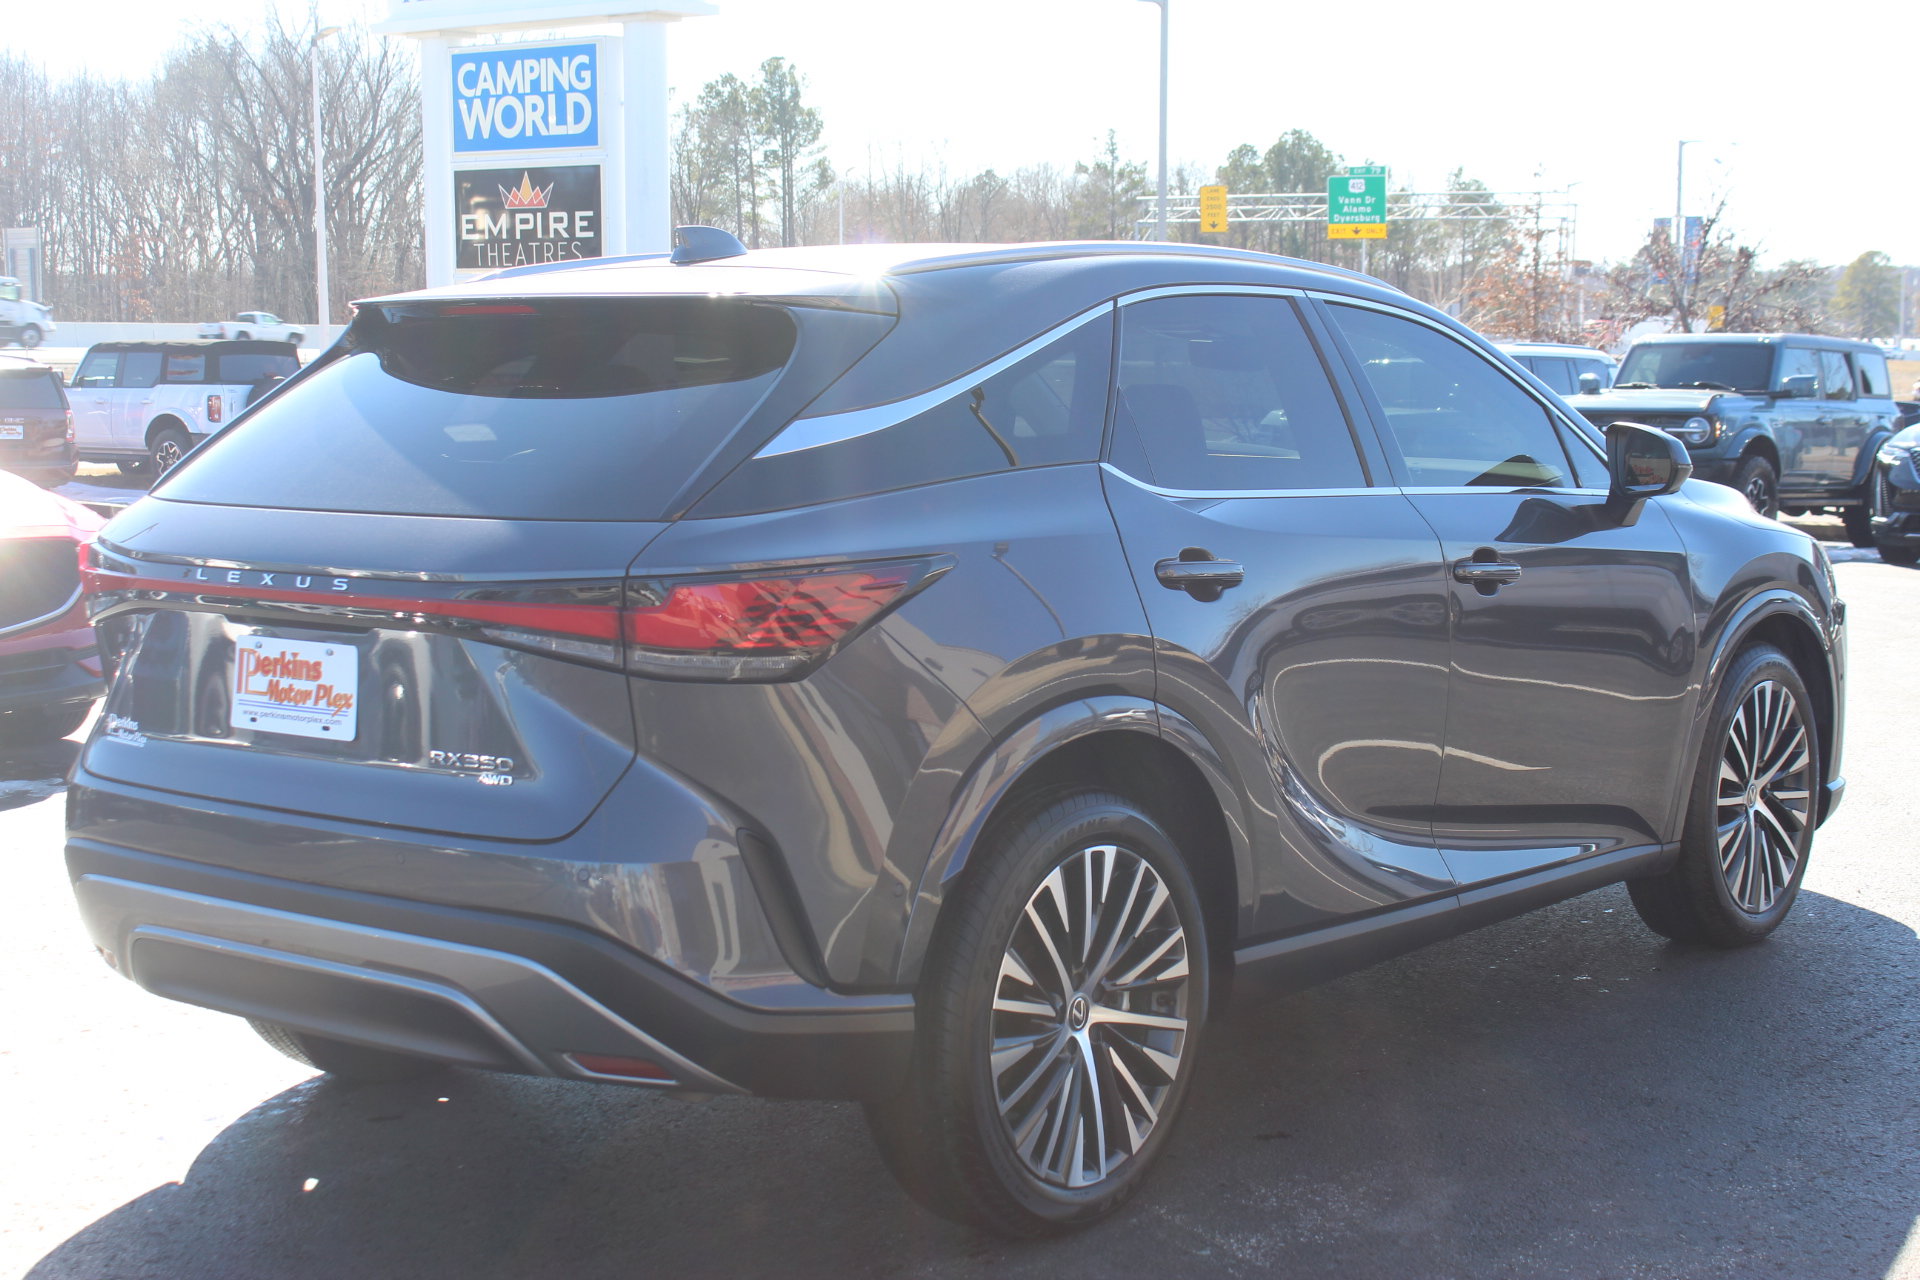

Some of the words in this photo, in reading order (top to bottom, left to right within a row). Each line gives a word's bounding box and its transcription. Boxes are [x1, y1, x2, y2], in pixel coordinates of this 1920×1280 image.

[457, 55, 592, 97] CAMPING
[458, 92, 592, 140] WORLD
[1350, 181, 1364, 191] 412
[1338, 196, 1362, 204] Vann
[1365, 196, 1376, 204] Dr
[1342, 205, 1372, 213] Alamo
[461, 211, 595, 240] EMPIRE
[1333, 214, 1381, 223] Dyersburg
[473, 241, 584, 267] THEATRES
[196, 568, 349, 591] LEXUS
[237, 647, 323, 694] Perkins
[267, 678, 314, 706] Motor
[313, 683, 354, 717] Plex
[478, 771, 513, 786] AWD
